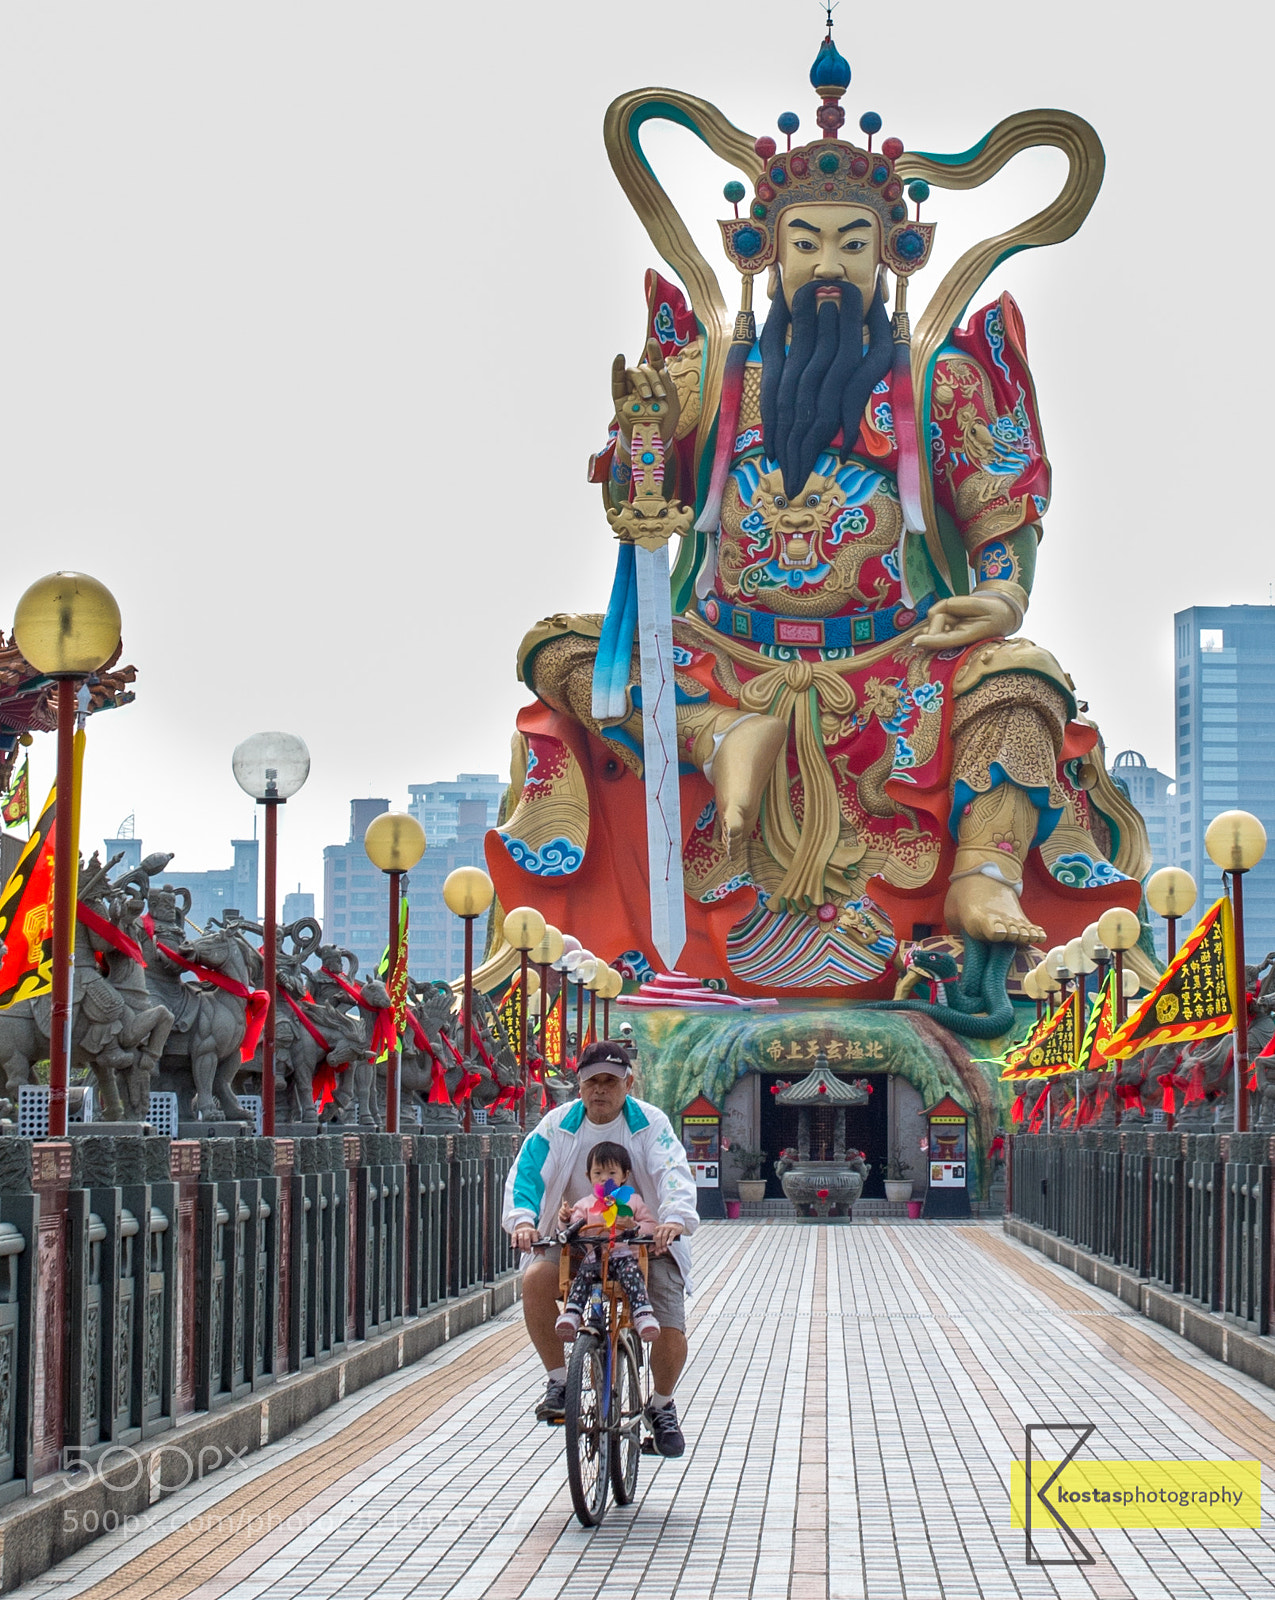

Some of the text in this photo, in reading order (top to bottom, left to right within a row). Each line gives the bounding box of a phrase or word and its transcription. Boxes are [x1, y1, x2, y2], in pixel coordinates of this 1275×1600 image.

[766, 1039, 884, 1062] 北極玄天上帝
